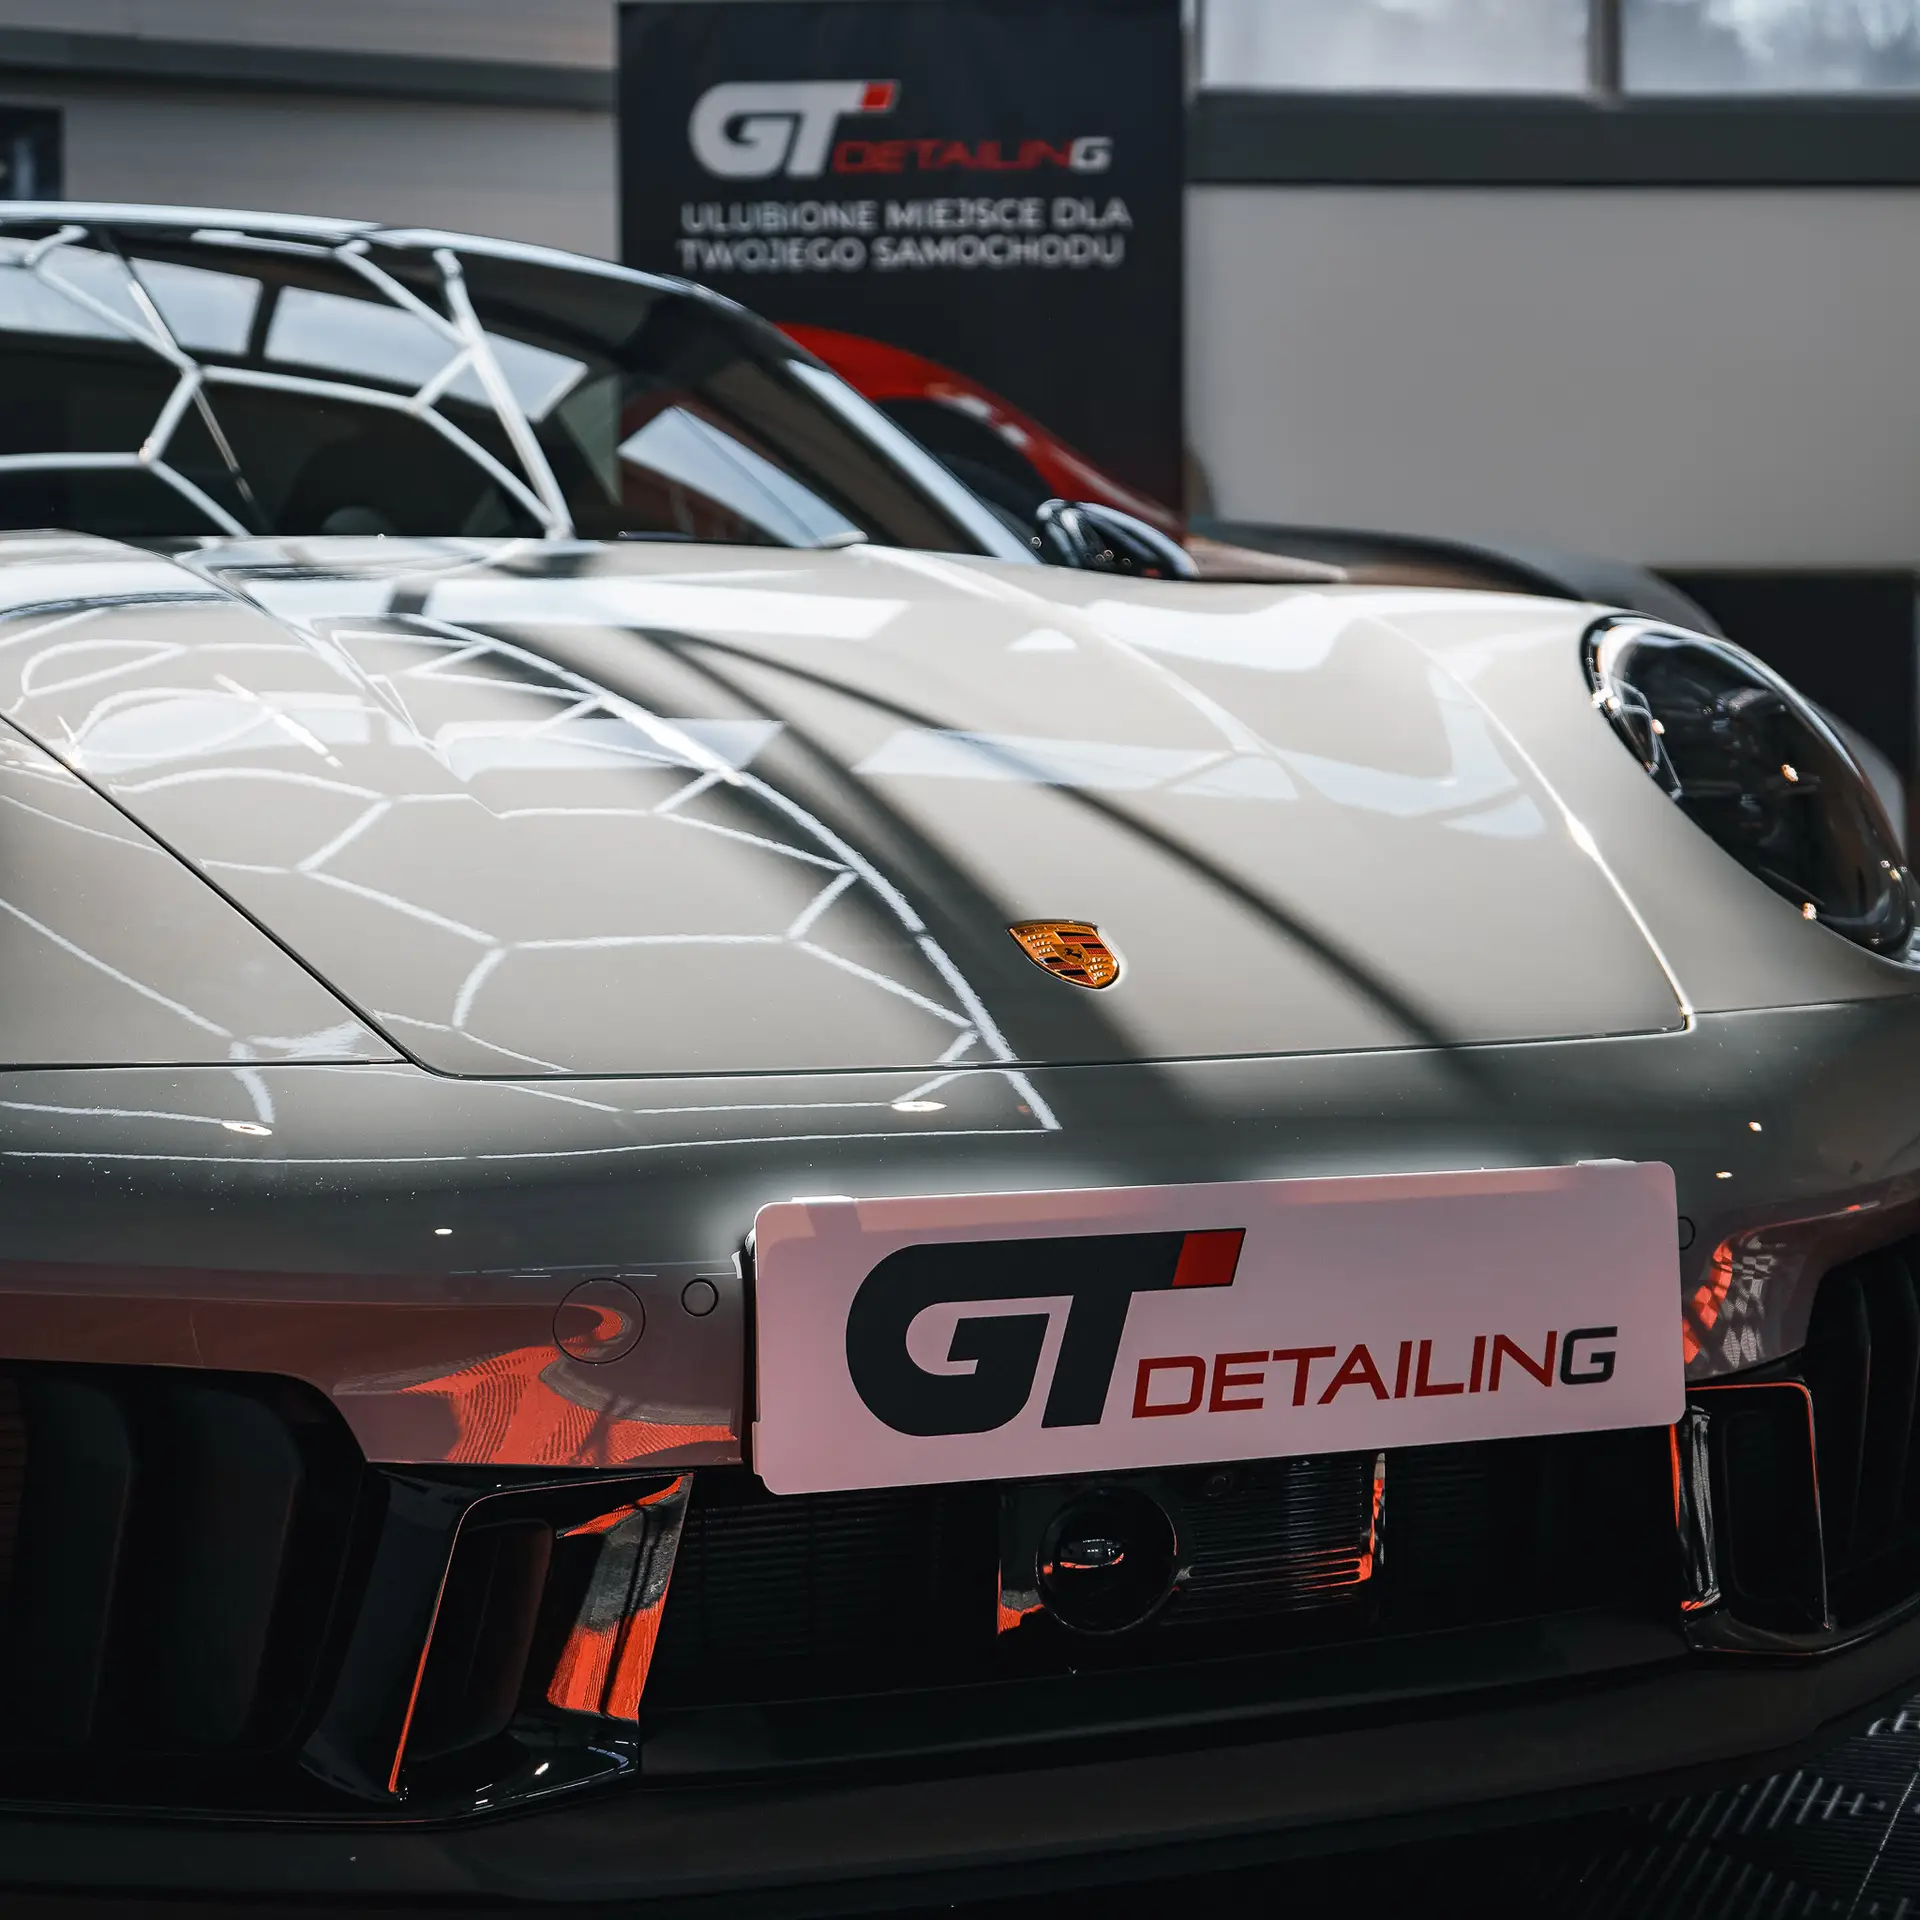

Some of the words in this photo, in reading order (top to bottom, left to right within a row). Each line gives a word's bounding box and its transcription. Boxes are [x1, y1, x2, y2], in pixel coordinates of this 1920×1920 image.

[690, 80, 897, 179] GT
[832, 136, 1112, 173] DETAILING
[681, 203, 875, 232] ULUBIONE
[885, 201, 1043, 230] MIEJSCE
[1053, 199, 1131, 229] DLA
[678, 239, 867, 270] TWOJEGO
[873, 236, 1124, 268] SAMOCHODU
[846, 1228, 1246, 1437] GT
[1132, 1326, 1618, 1419] DETAILING
